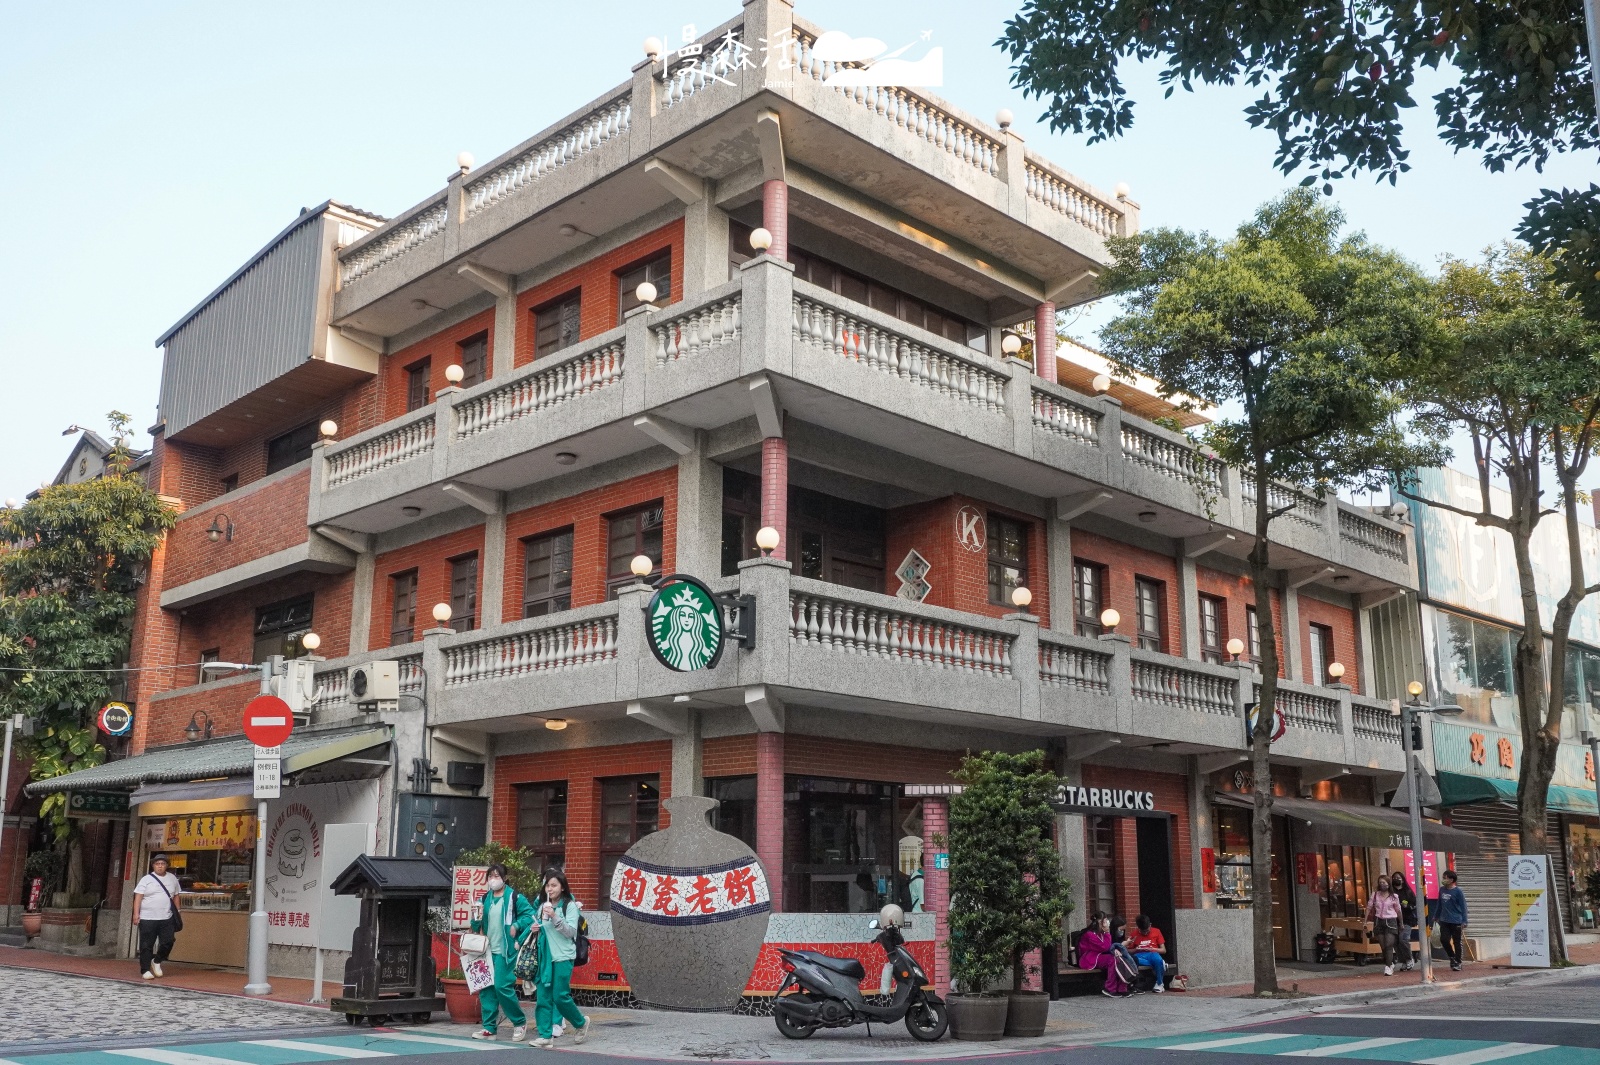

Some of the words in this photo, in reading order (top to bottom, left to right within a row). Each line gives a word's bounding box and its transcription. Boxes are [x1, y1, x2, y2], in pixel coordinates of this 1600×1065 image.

[961, 511, 982, 547] K
[257, 763, 278, 771] 例假日
[1057, 785, 1154, 811] STARBUCKS
[266, 811, 286, 857] BRIOCHE
[286, 802, 314, 825] CINNAMON
[309, 821, 320, 858] ROLLS
[453, 868, 471, 925] 營業中
[618, 867, 757, 917] 陶瓷老街
